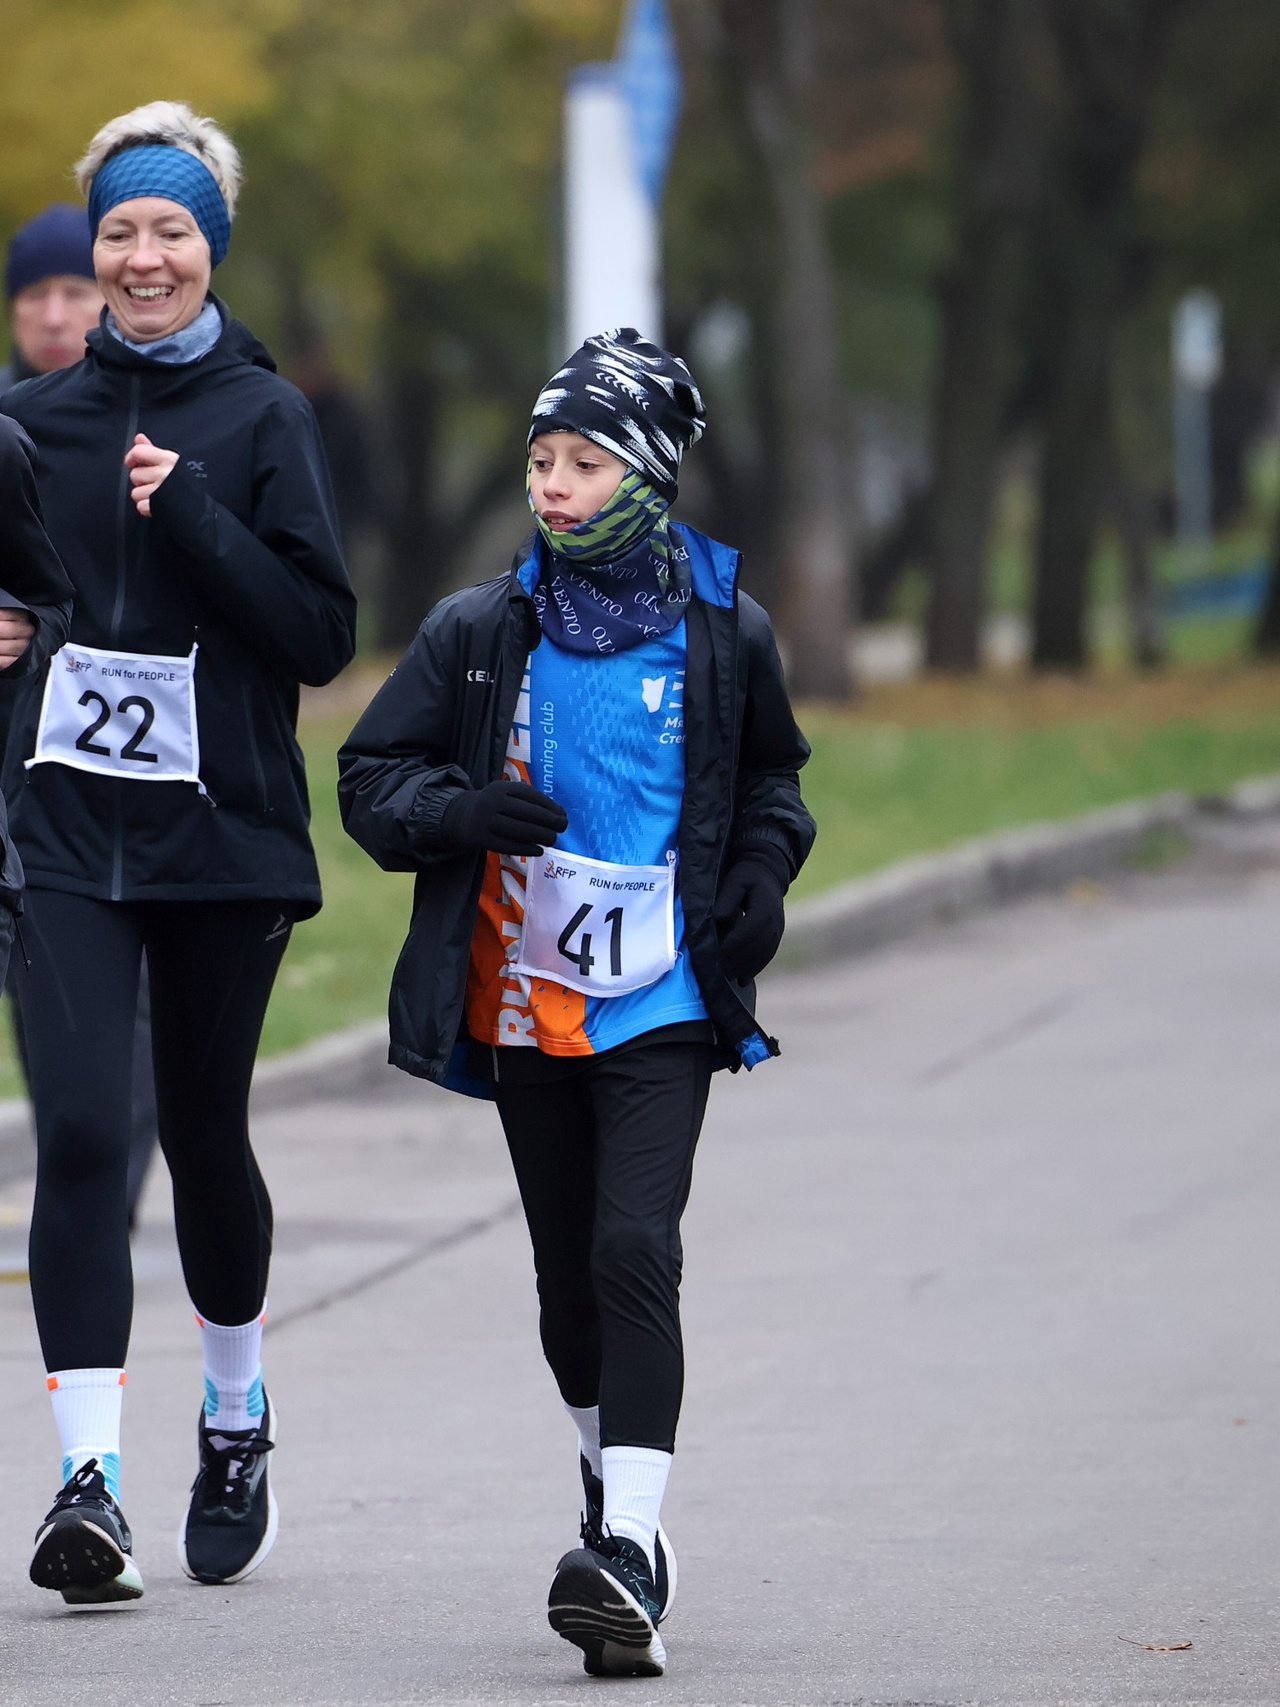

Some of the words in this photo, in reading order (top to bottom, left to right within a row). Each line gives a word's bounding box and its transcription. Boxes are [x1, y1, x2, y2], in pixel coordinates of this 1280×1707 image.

[550, 575, 582, 635] VENTO
[569, 573, 624, 617] VENTO
[76, 661, 92, 673] RFP
[101, 667, 122, 678] RUN
[123, 670, 136, 679] for
[138, 671, 176, 682] PEOPLE
[75, 690, 158, 763] 22
[539, 701, 554, 735] club
[556, 866, 577, 879] RFP
[589, 877, 611, 890] RUN
[612, 881, 624, 891] for
[623, 882, 656, 892] PEOPLE
[557, 902, 624, 977] 41
